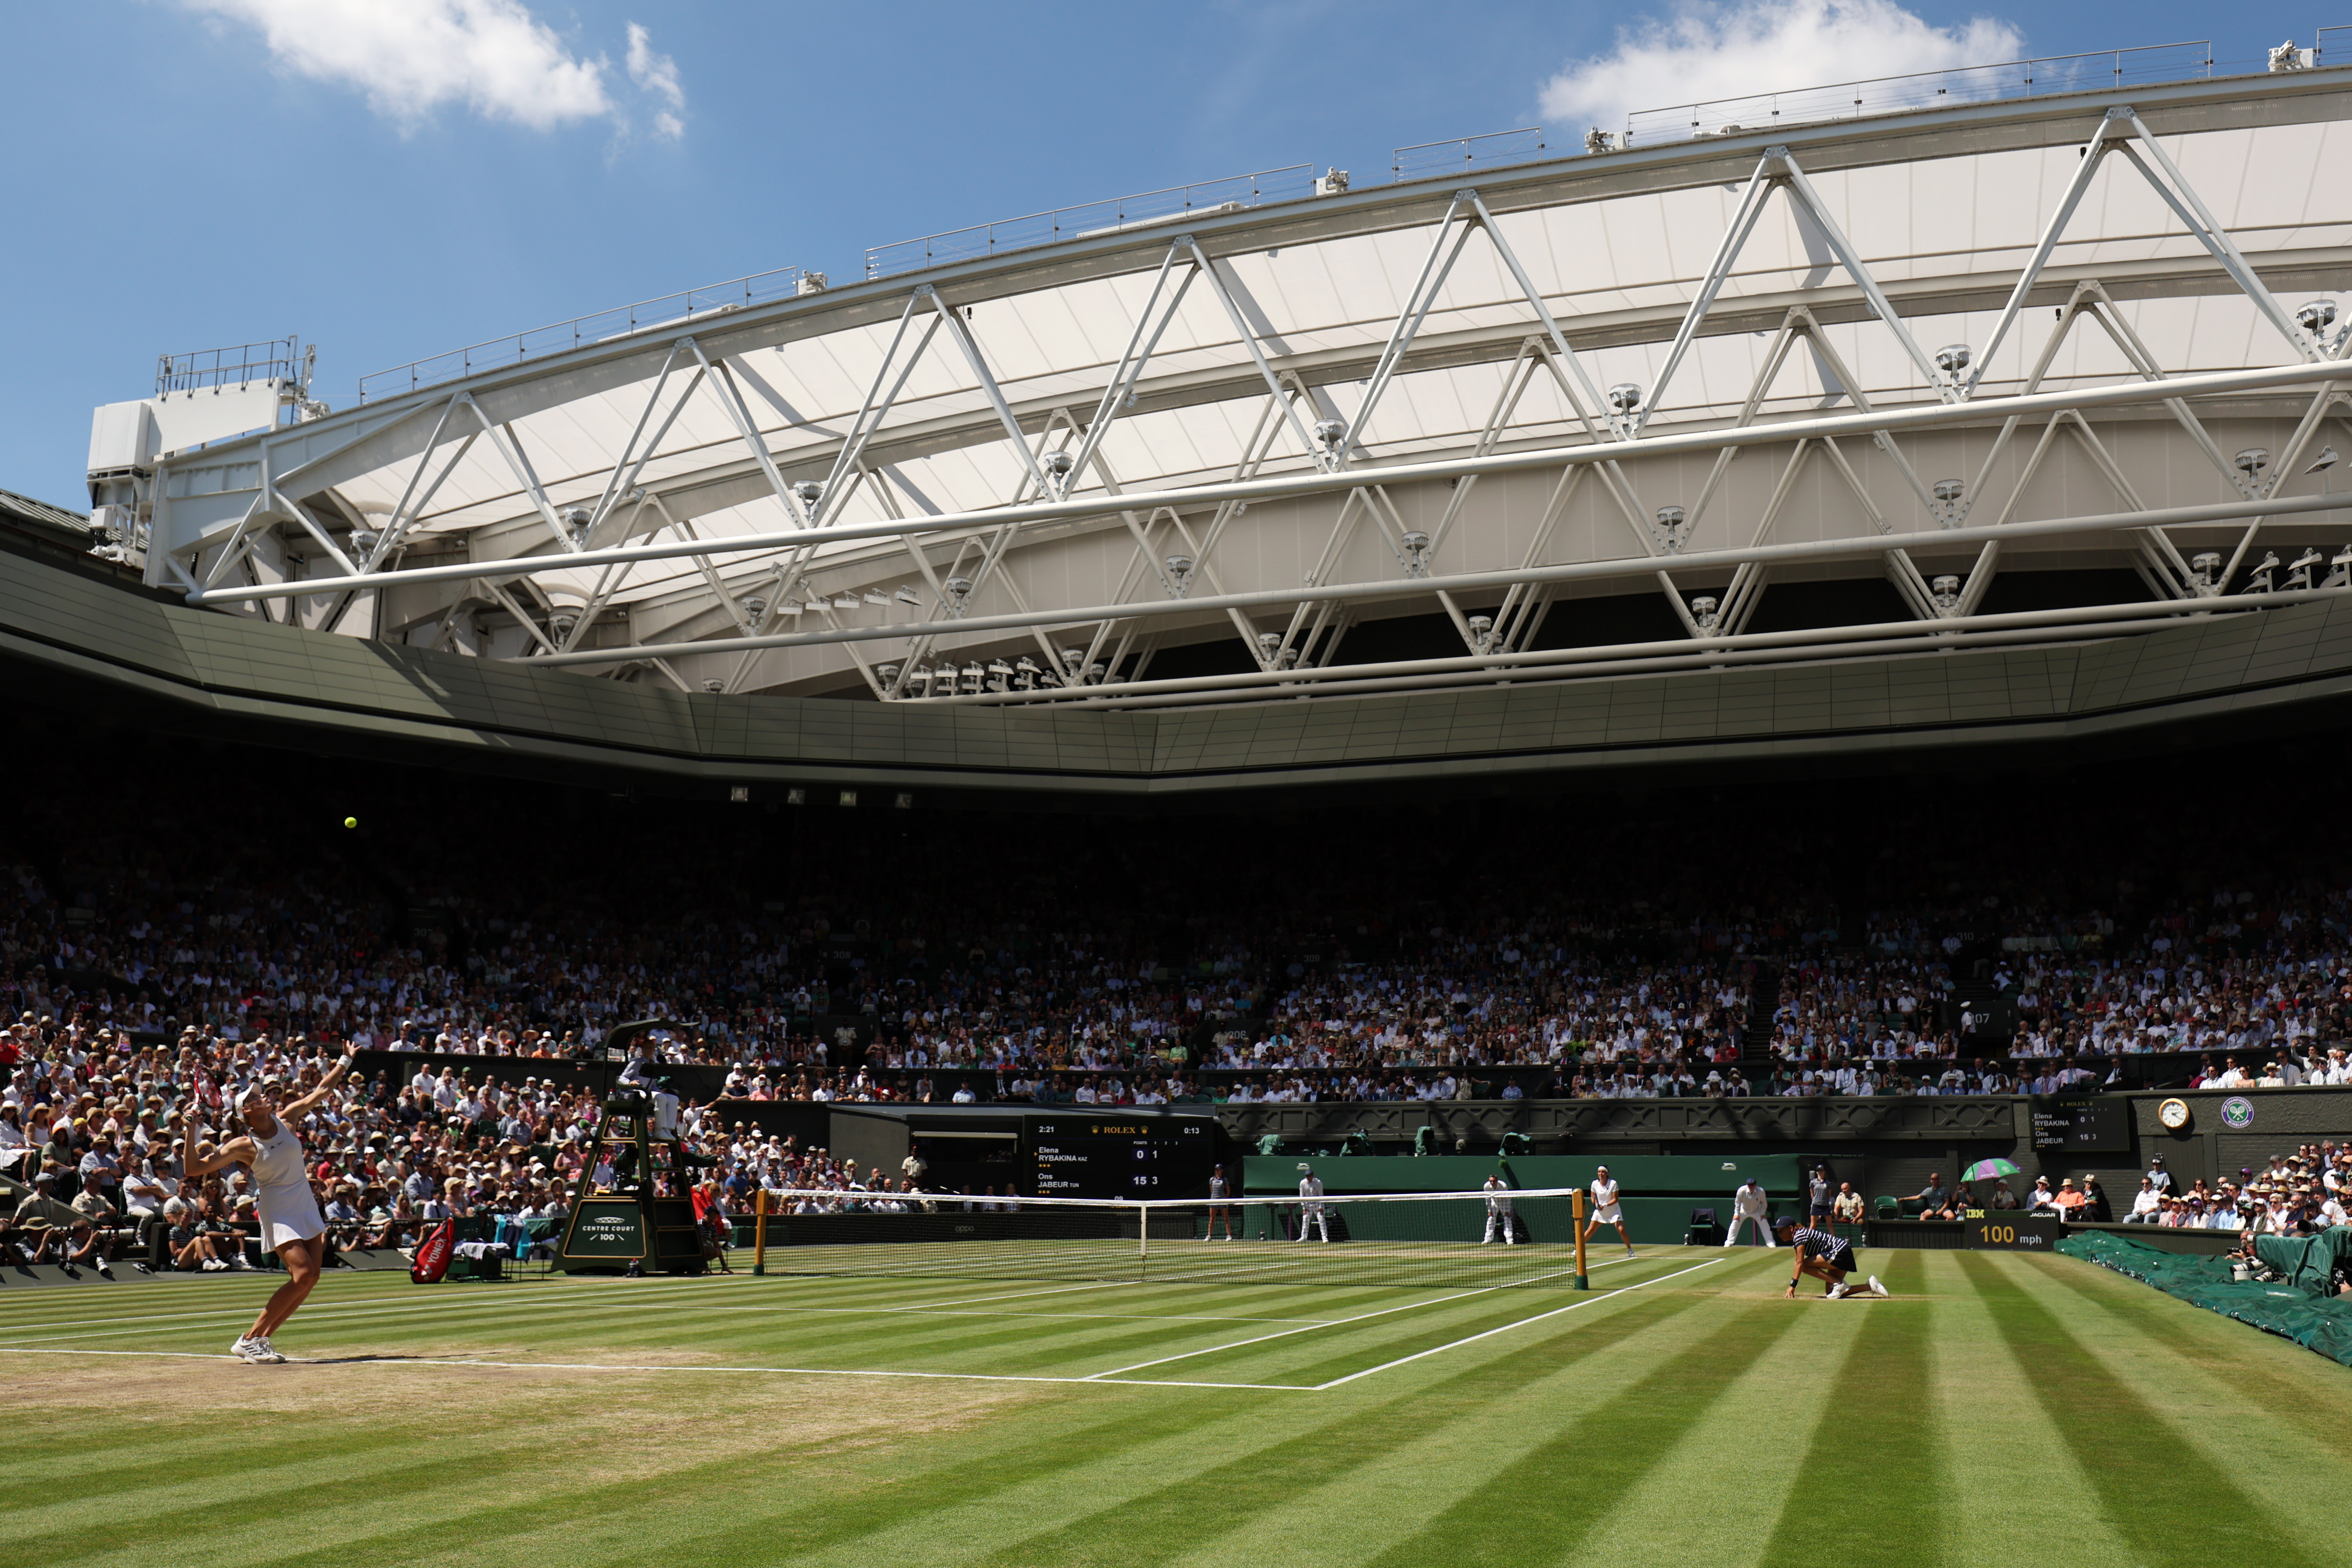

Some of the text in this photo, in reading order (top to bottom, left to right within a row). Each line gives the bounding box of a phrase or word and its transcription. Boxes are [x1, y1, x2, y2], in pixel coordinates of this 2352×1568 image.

[1304, 954, 1320, 963] 309
[1973, 1013, 1990, 1023] 07
[1136, 1150, 1157, 1159] 0 1
[1133, 1177, 1158, 1185] 15 3
[1965, 1209, 1985, 1219] IBM
[1980, 1225, 2042, 1246] 100 mph
[427, 1236, 447, 1263] YONEX
